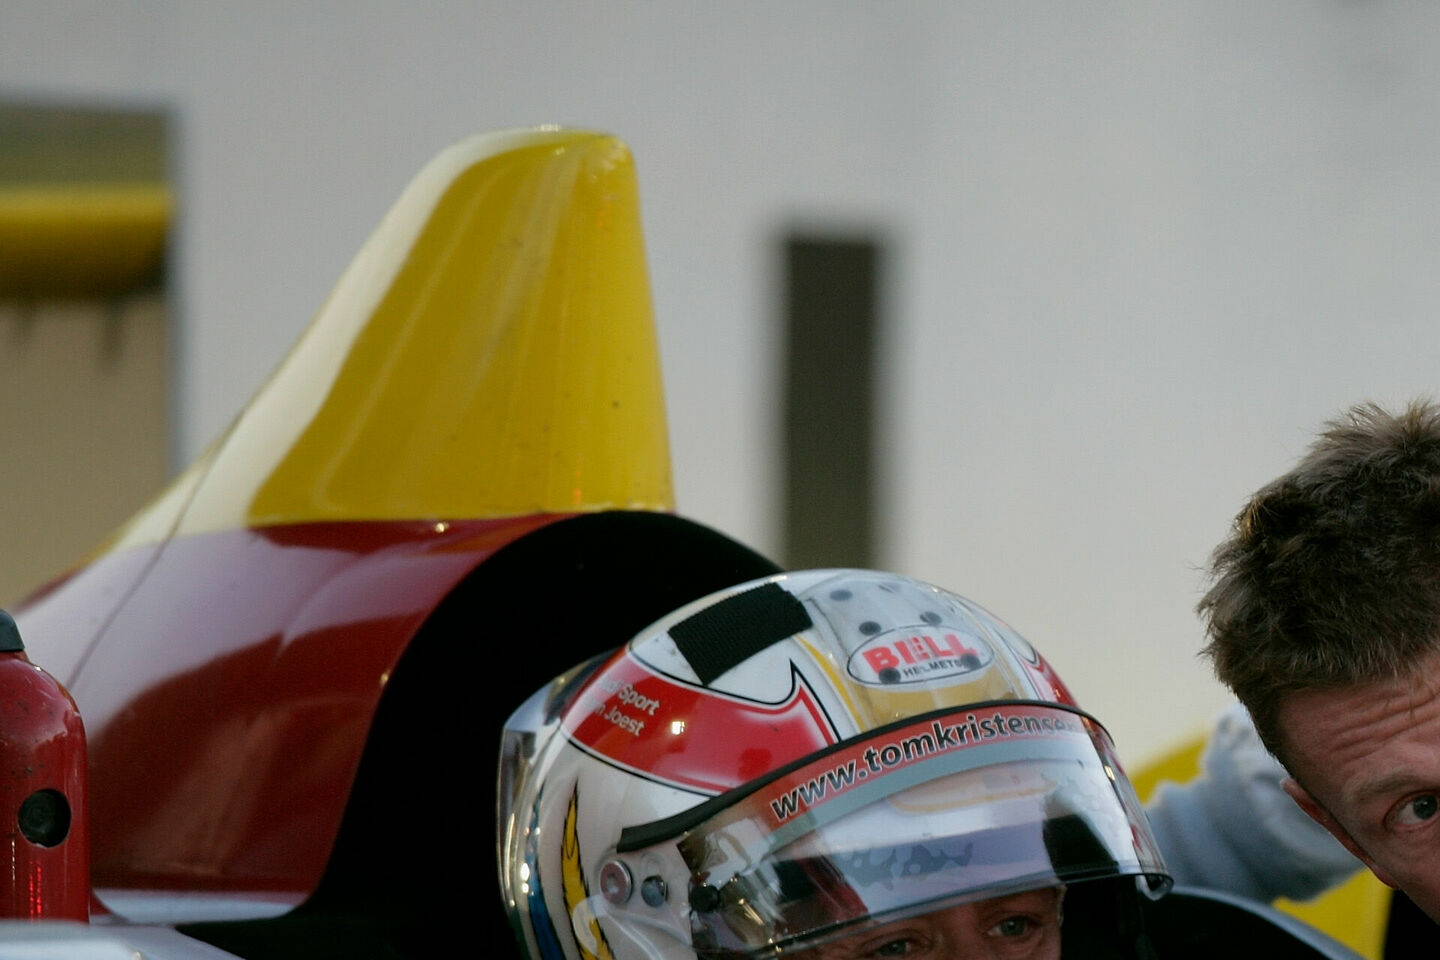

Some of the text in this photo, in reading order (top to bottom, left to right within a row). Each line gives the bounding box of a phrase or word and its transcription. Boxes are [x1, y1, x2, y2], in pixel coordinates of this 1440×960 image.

[861, 633, 979, 675] BELL
[618, 682, 660, 716] Sport
[604, 705, 645, 737] Joest
